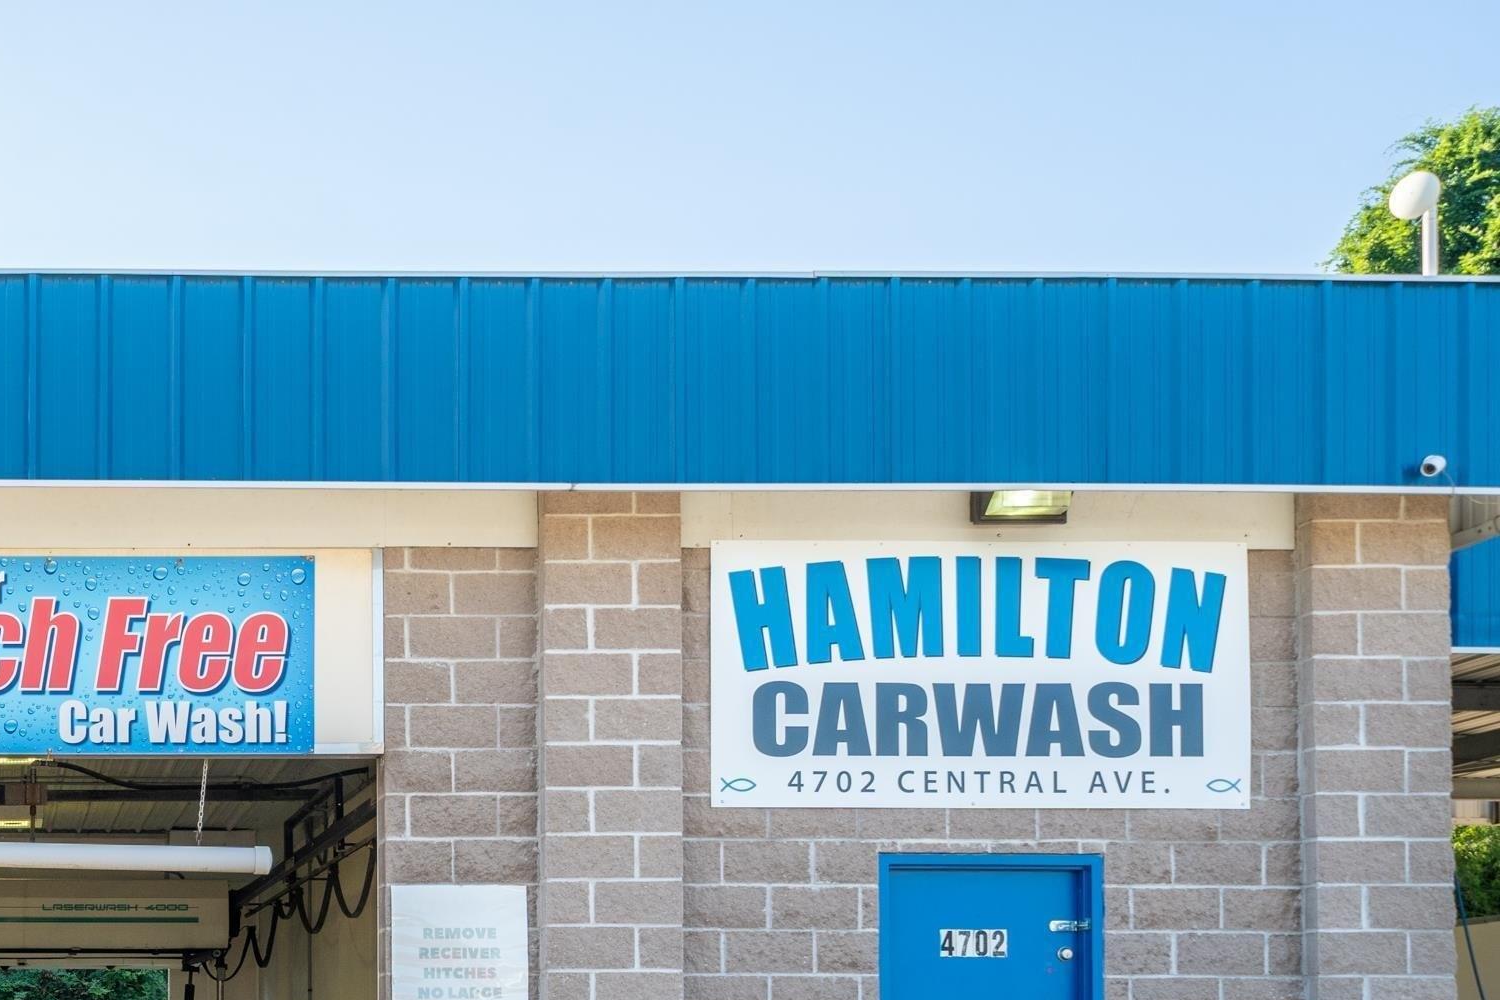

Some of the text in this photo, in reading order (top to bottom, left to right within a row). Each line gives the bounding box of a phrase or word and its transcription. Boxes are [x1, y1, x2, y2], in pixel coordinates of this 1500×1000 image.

[728, 555, 1227, 673] HAMILTON
[93, 596, 291, 694] Free
[58, 700, 288, 745] Car Wash!
[751, 680, 1204, 758] CARWASH
[788, 770, 1172, 794] 4702 CENTRAL AVE.
[42, 903, 189, 911] LASERWASH 4000
[423, 927, 498, 939] REMOVE
[941, 930, 1005, 956] 4702
[419, 947, 501, 959] RECEIVER
[423, 967, 497, 979] HITCHES
[418, 986, 444, 999] NO
